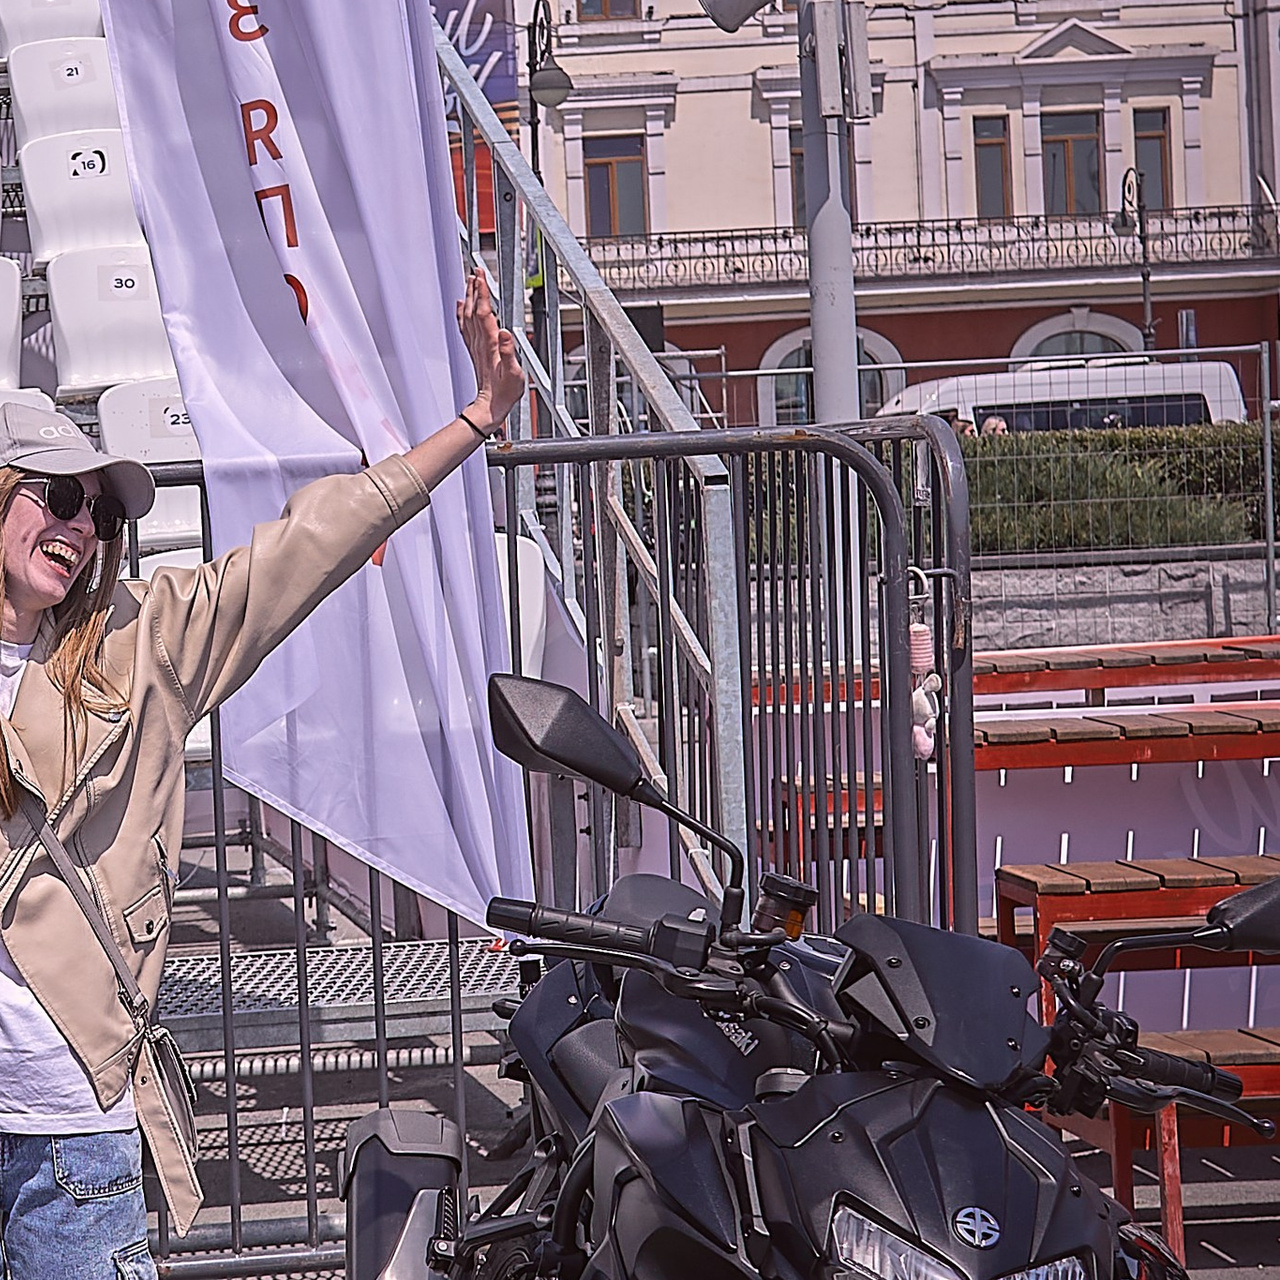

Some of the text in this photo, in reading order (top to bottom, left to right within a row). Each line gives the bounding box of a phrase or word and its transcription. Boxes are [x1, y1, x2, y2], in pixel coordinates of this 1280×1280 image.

[66, 66, 79, 77] 21
[81, 159, 96, 171] 16
[114, 278, 135, 289] 30
[715, 1021, 759, 1057] saki
